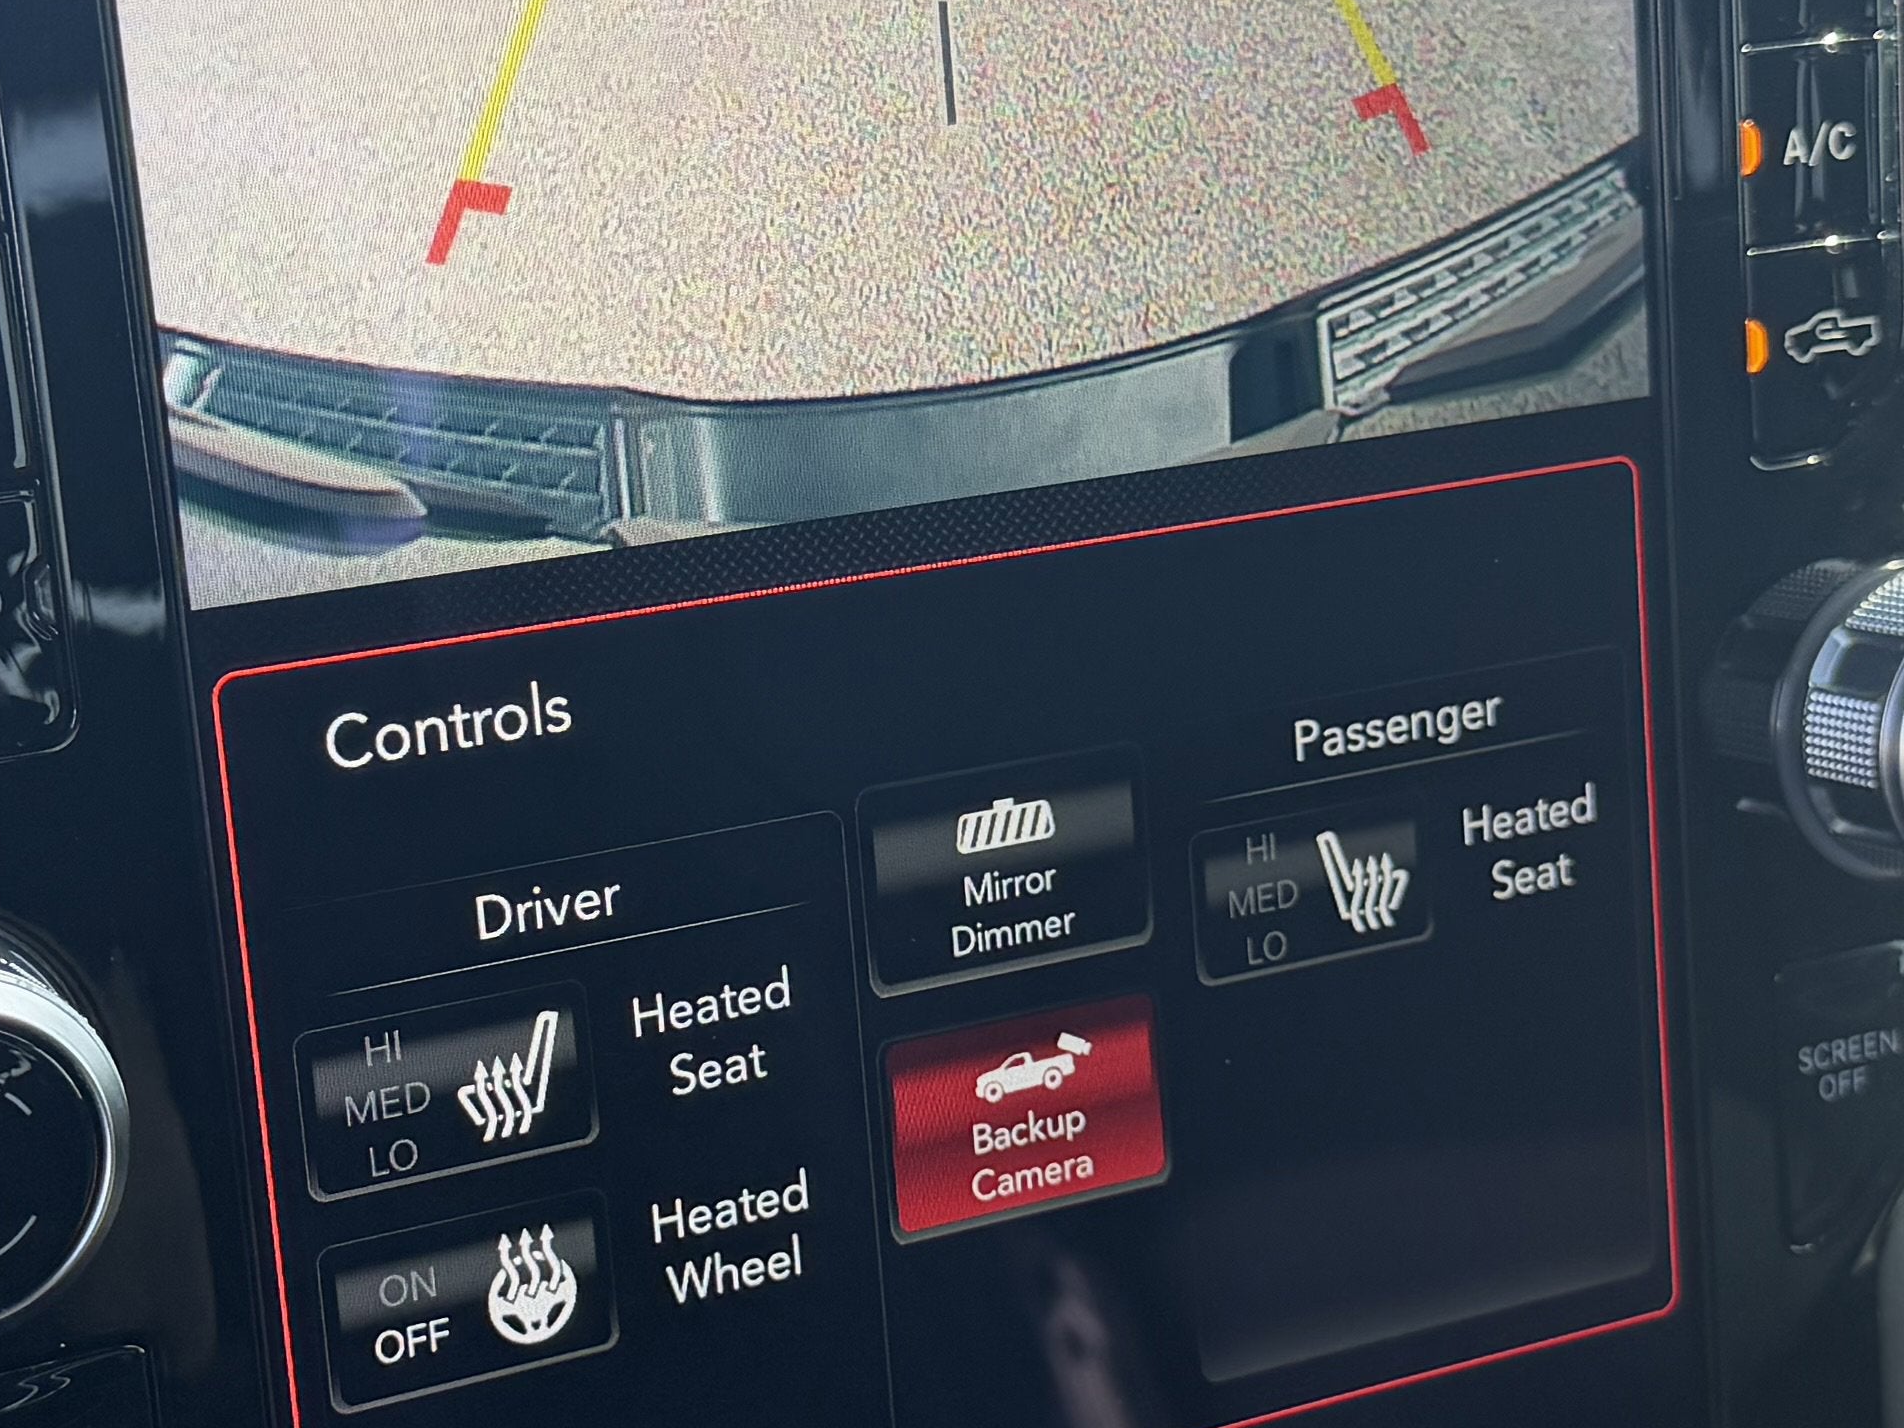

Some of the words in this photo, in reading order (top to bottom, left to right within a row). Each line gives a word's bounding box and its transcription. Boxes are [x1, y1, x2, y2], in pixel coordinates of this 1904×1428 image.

[1783, 120, 1856, 167] A/C
[324, 680, 573, 771] Controls
[1293, 695, 1504, 763] Passenger
[1461, 782, 1599, 847] Heated
[1245, 832, 1276, 864] HI
[963, 864, 1057, 908] Mirror
[1228, 879, 1296, 920] MED
[1491, 852, 1576, 901] Seat
[475, 881, 621, 941] Driver
[951, 906, 1076, 958] Dimmer
[1246, 931, 1288, 966] LO
[631, 965, 792, 1039] Heated
[364, 1030, 402, 1066] HI
[670, 1044, 768, 1096] Seat
[1798, 1028, 1900, 1074] SCREEN
[344, 1081, 431, 1127] MED
[1818, 1065, 1870, 1103] OFF
[972, 1104, 1087, 1156] Backup
[369, 1139, 418, 1179] LO
[971, 1150, 1095, 1204] Camera
[650, 1168, 810, 1244] Heated
[378, 1267, 438, 1308] ON
[666, 1237, 803, 1305] Wheel
[374, 1318, 451, 1365] OFF
